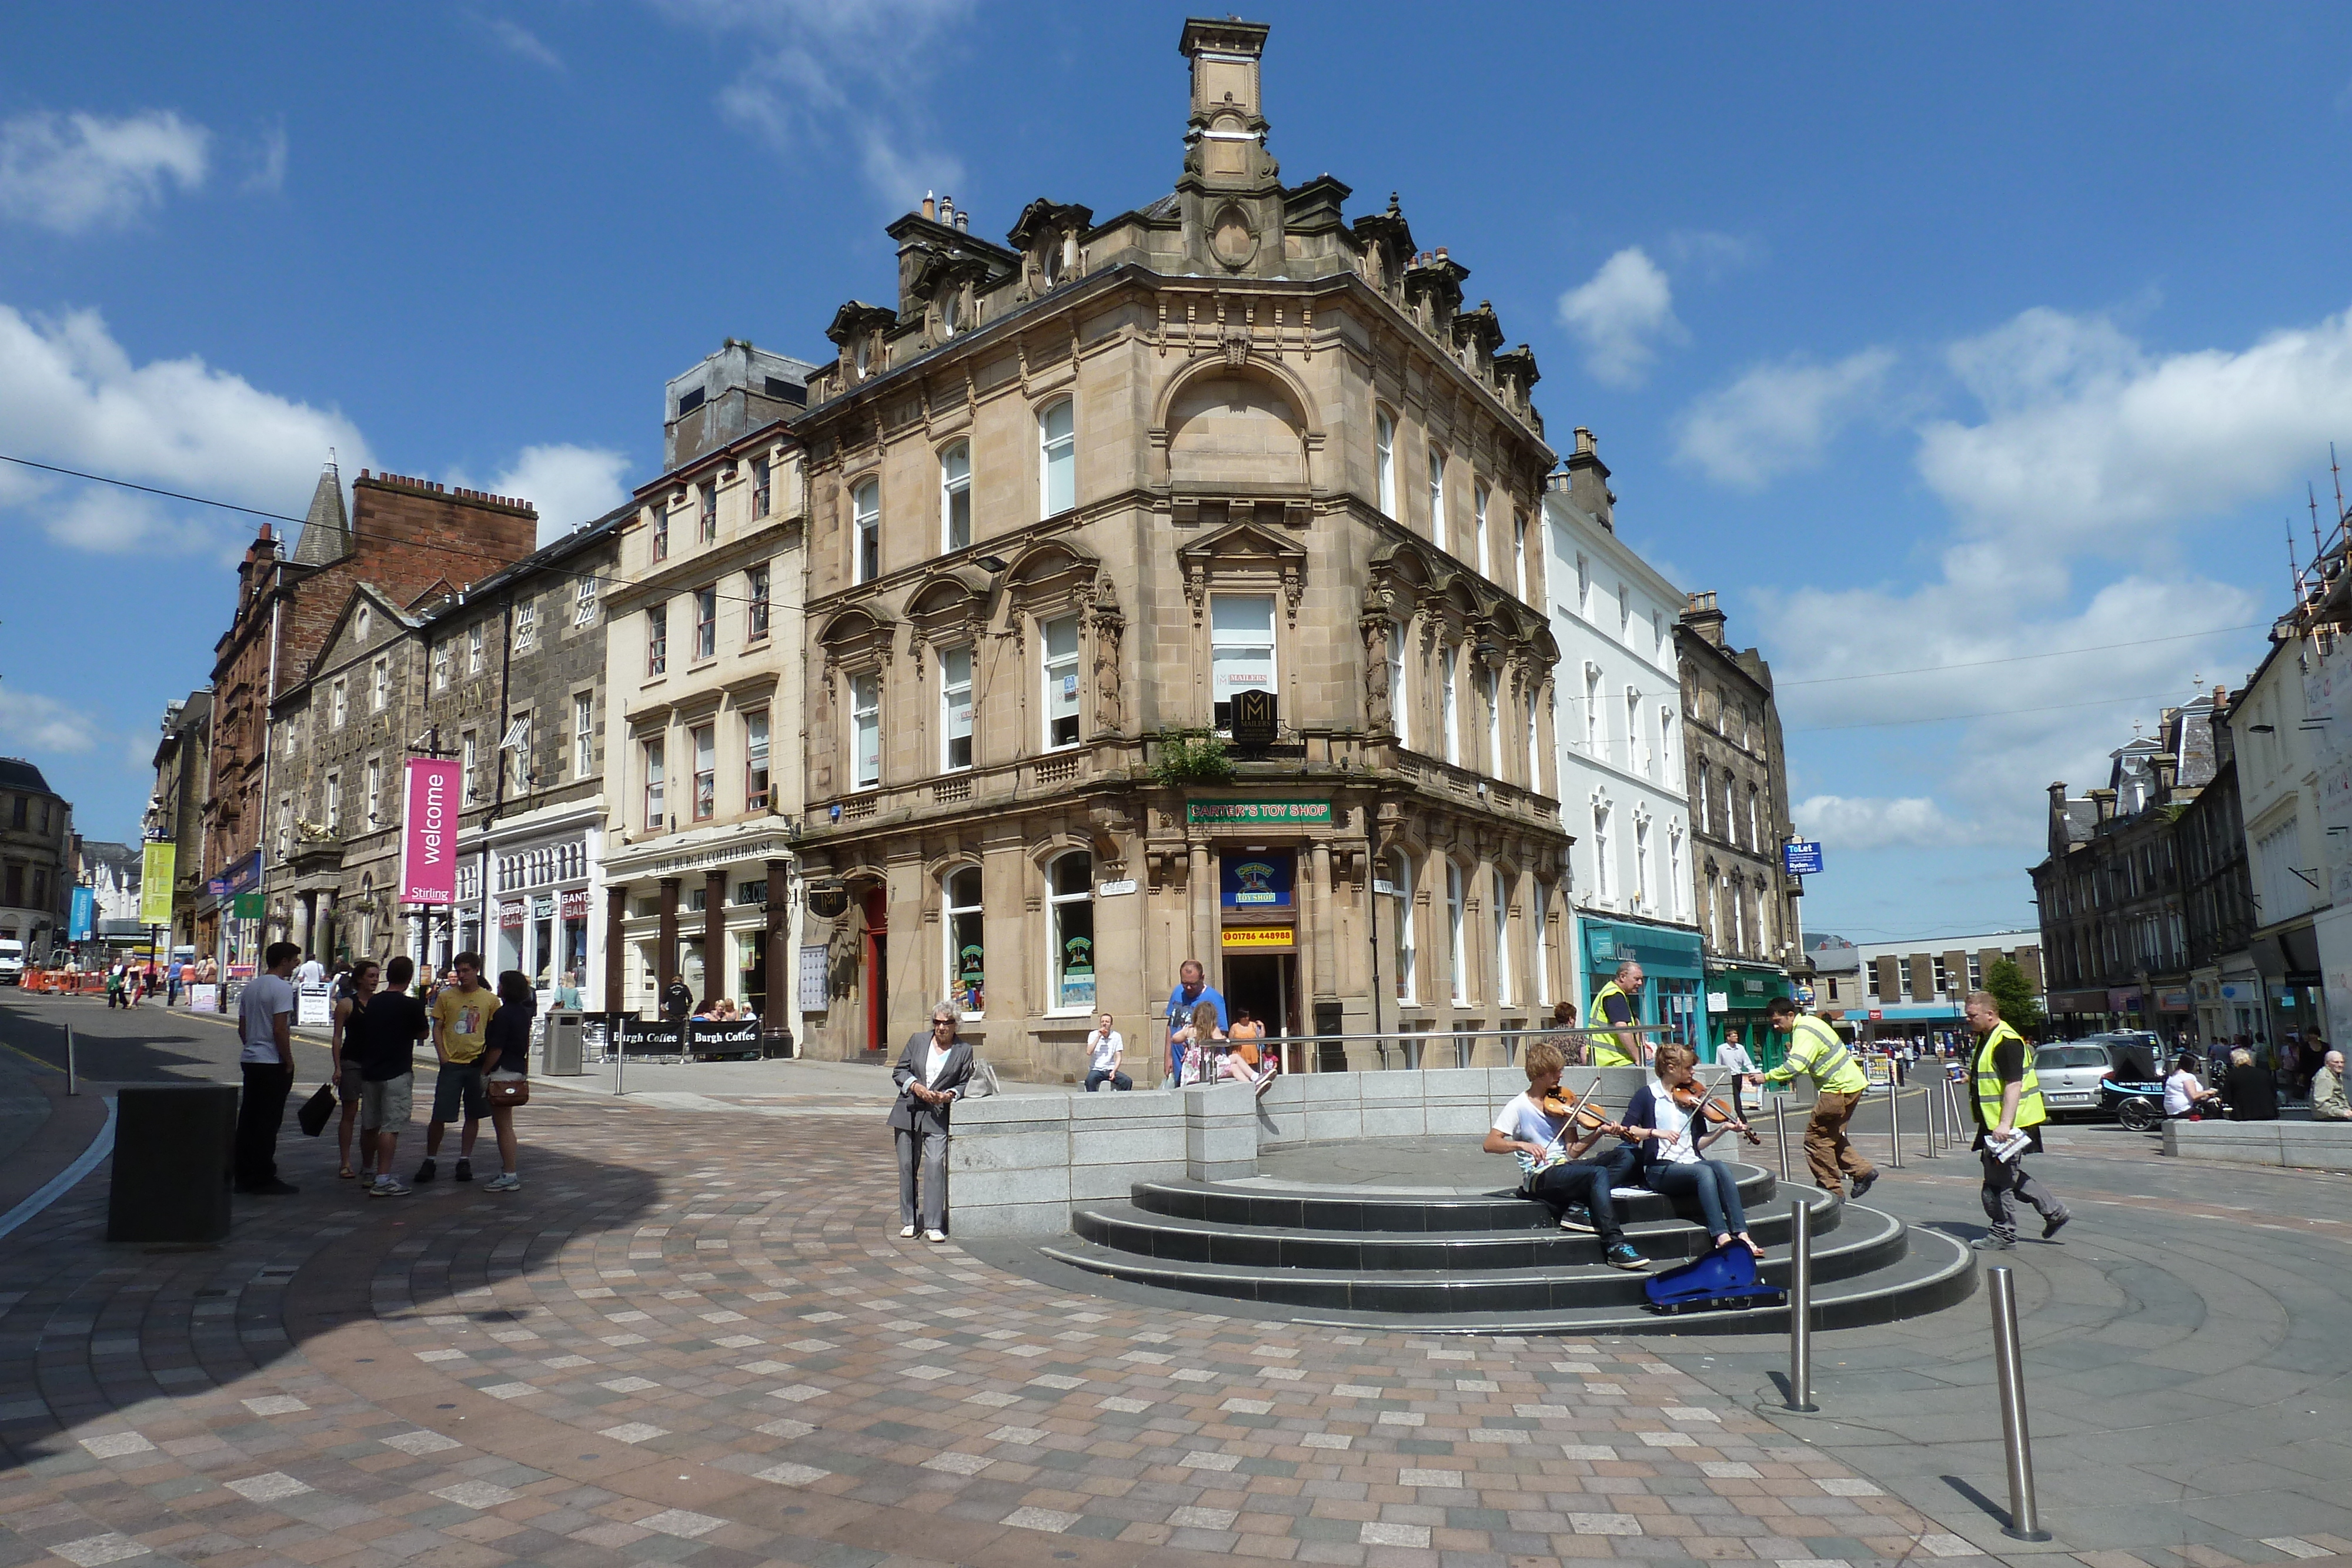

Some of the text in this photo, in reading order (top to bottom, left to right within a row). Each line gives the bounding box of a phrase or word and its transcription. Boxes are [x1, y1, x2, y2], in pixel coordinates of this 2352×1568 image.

[1191, 804, 1328, 817] CARTER'S TOY SHOP
[420, 774, 444, 865] welcome
[655, 840, 773, 872] THE BURGH COFFEEHOUSE
[412, 887, 449, 901] Stirling
[562, 891, 588, 904] GANT
[501, 903, 523, 917] Superdry
[647, 1032, 677, 1043] Coffee
[694, 1031, 756, 1044] Burgh Coffee
